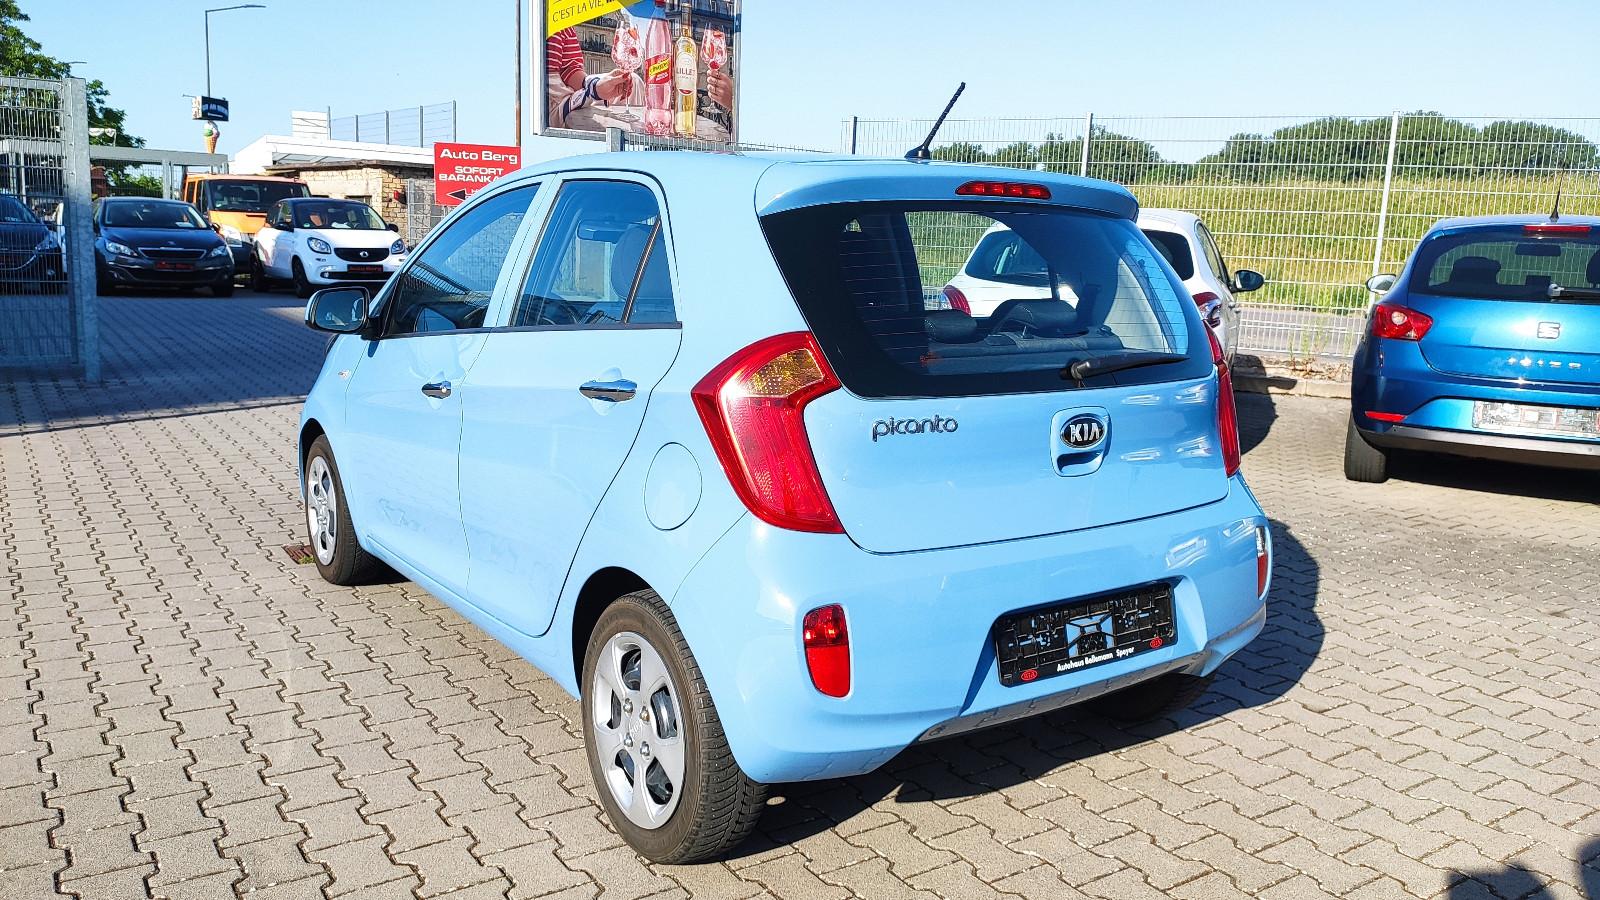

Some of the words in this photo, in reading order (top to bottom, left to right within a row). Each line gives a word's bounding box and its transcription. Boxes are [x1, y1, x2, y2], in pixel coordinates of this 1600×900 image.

[552, 6, 575, 22] C'EST
[577, 3, 587, 14] LA
[440, 148, 478, 160] Auto
[481, 151, 518, 165] Berg
[454, 165, 504, 175] SOFORT
[872, 414, 959, 443] picanto
[1069, 421, 1101, 444] KIA
[1057, 660, 1084, 672] Autohaus
